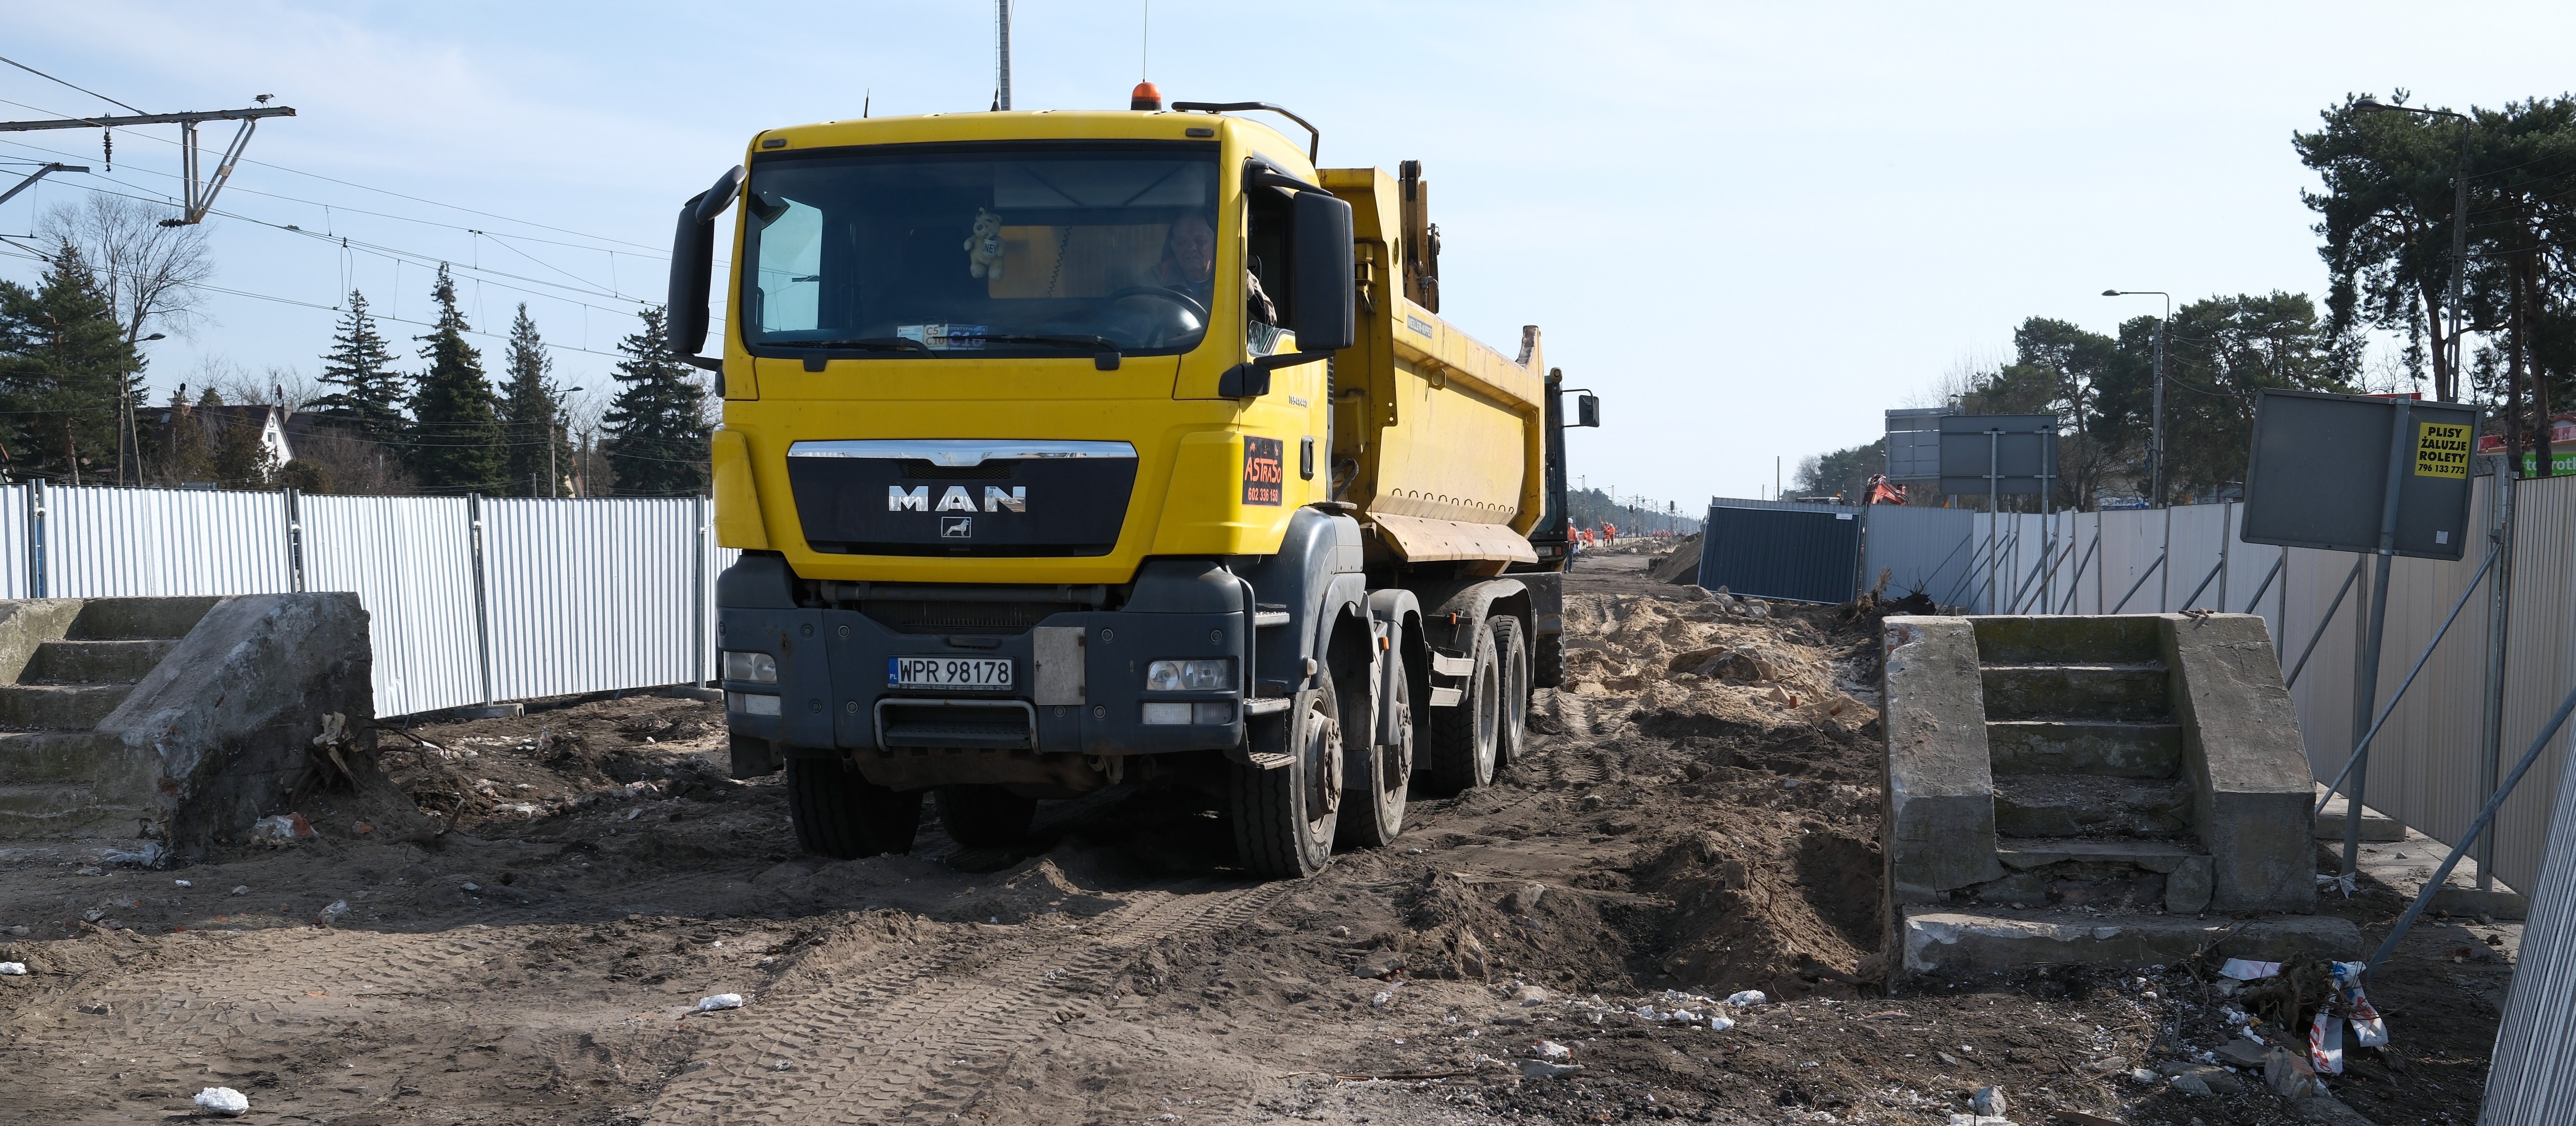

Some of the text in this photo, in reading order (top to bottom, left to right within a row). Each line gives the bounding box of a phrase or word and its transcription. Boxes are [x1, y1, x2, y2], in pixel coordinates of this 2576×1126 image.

[926, 327, 939, 335] C5
[925, 337, 945, 345] C10
[2428, 427, 2463, 438] PLISY
[2421, 436, 2467, 451] ŻALUZJE
[2419, 451, 2466, 463] ROLETY
[889, 486, 1026, 512] MAN
[1248, 488, 1258, 501] 602
[1260, 488, 1269, 501] 336
[900, 660, 1008, 683] WPR 98178
